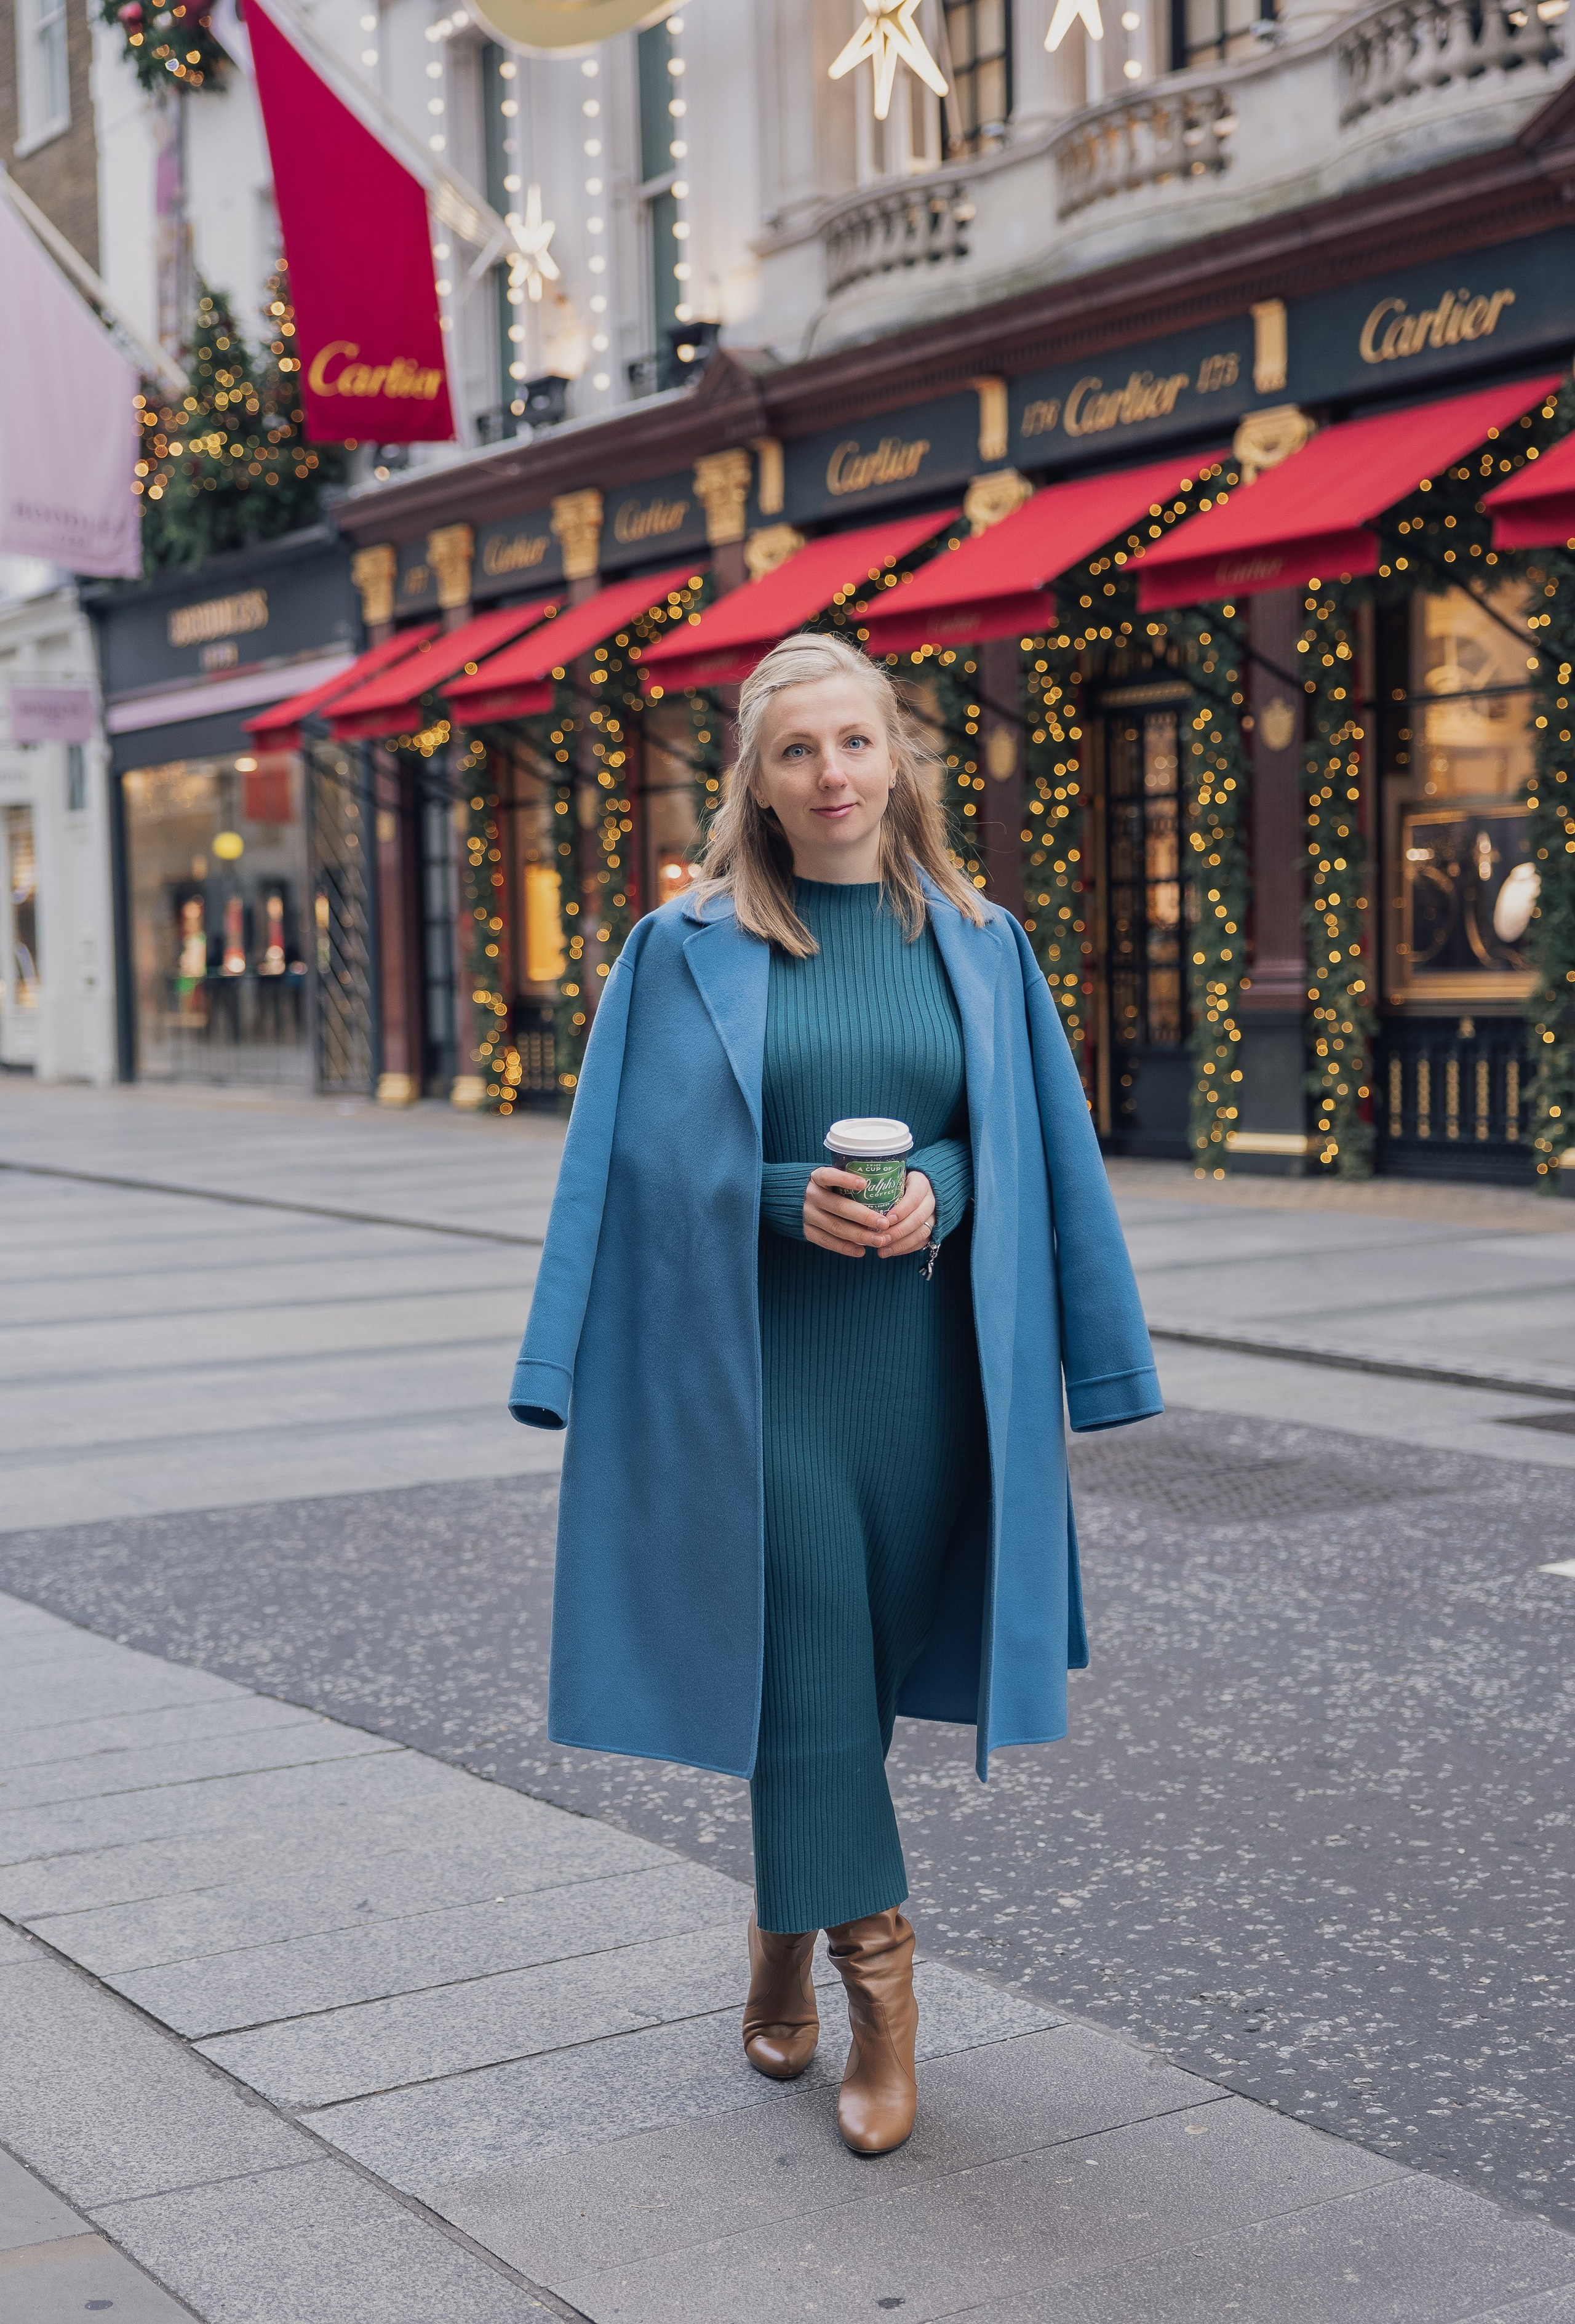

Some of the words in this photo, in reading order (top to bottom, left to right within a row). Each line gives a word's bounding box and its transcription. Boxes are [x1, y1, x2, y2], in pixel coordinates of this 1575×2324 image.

[1359, 287, 1515, 364] Cartier
[308, 340, 443, 401] Cartier
[1063, 371, 1190, 437] Cartier
[826, 437, 930, 495] Cartier
[614, 497, 689, 544] Cartier
[483, 533, 549, 577] Cartier
[861, 1177, 895, 1200] Ralph's
